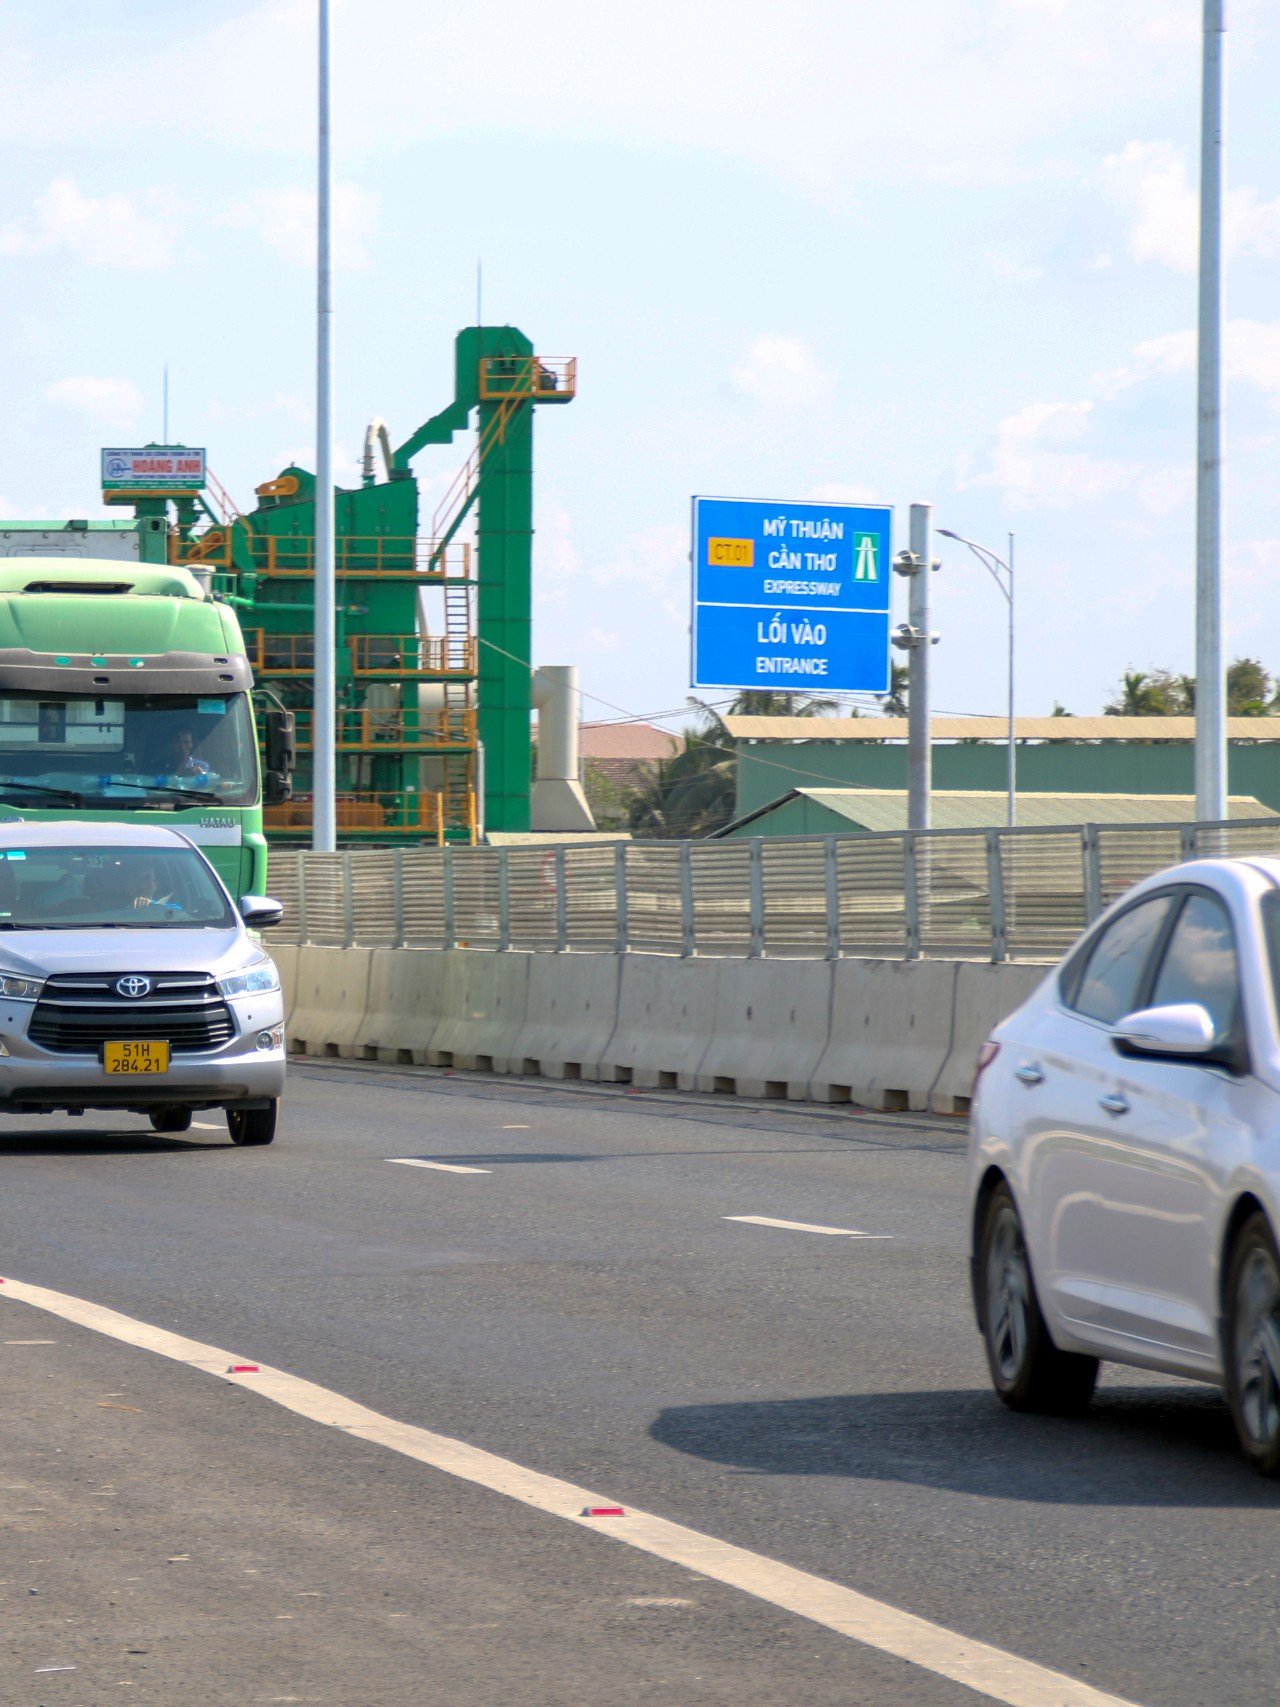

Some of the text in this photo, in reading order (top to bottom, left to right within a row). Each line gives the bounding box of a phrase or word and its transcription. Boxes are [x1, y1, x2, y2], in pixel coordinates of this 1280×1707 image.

[176, 459, 201, 474] ANH
[789, 518, 844, 543] THUẬN
[768, 543, 838, 572] CẦN THƠ
[763, 579, 841, 597] EXPRESSWAY
[757, 612, 827, 646] LỐI VÀO
[756, 656, 829, 676] ENTRANCE
[123, 1043, 150, 1057] 51H
[112, 1058, 160, 1073] 284.21
